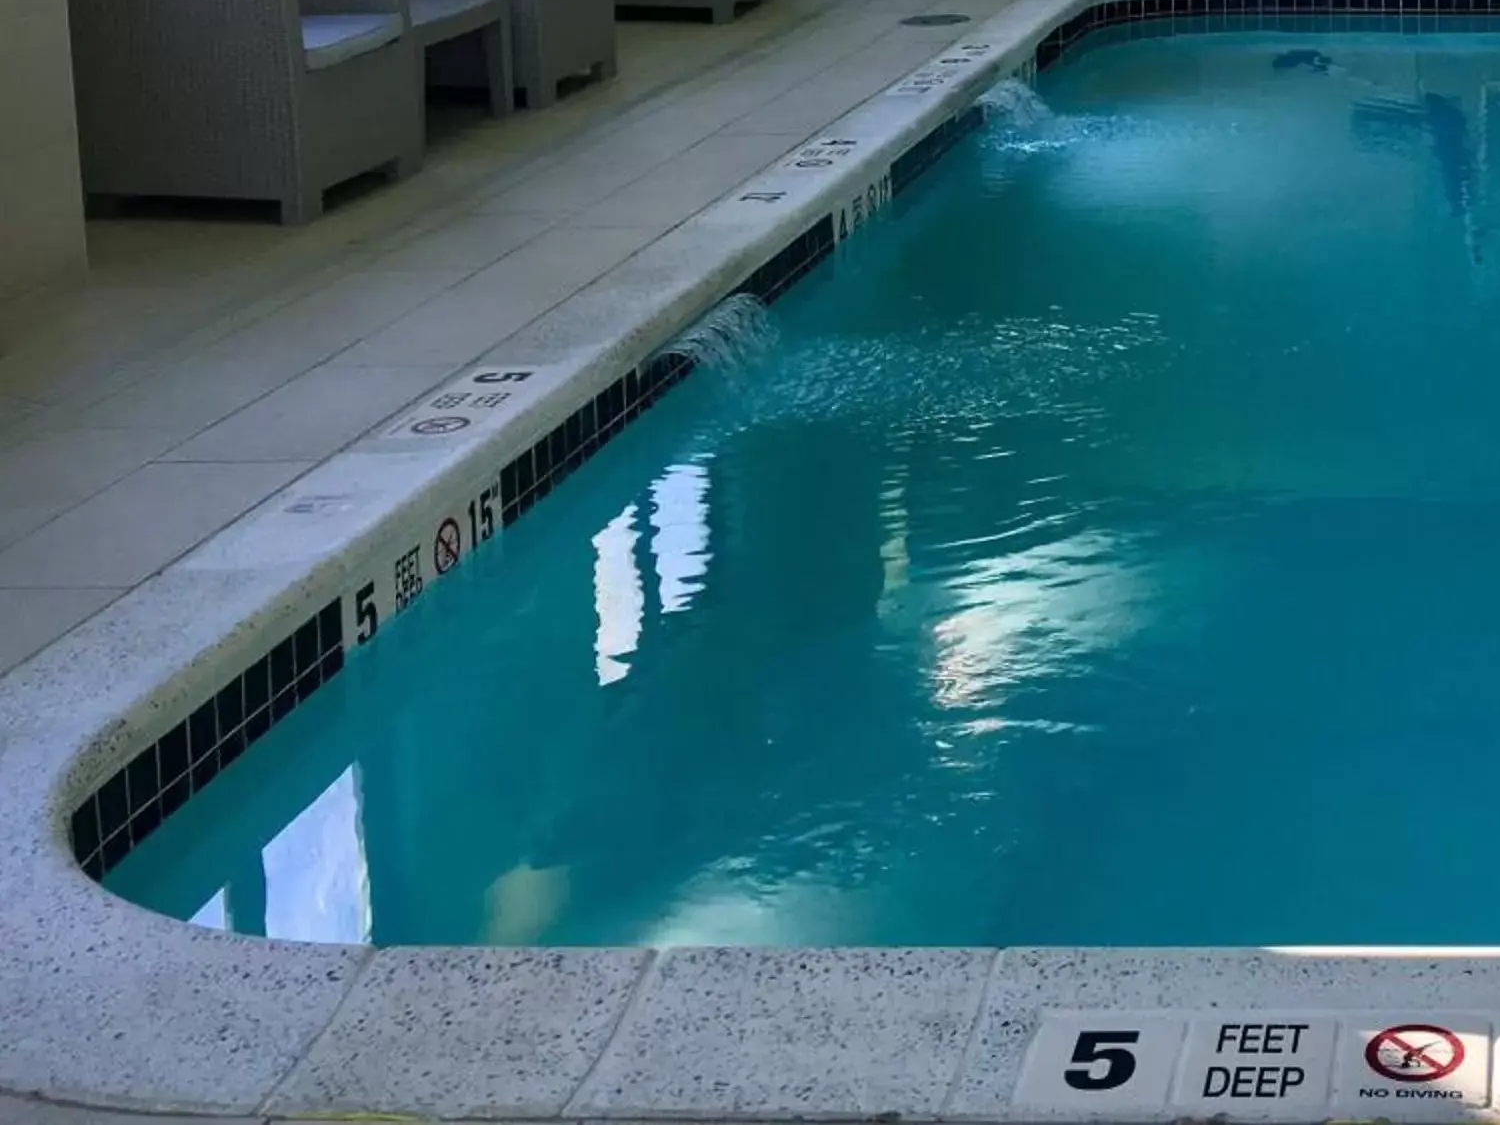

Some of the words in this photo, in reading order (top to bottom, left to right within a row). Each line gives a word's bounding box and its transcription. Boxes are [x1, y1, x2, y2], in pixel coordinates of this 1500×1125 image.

[355, 581, 379, 646] 5
[1063, 1031, 1141, 1091] 5
[1216, 1024, 1309, 1054] FEET
[1203, 1066, 1305, 1098] DEEP
[1359, 1088, 1390, 1098] NO
[1394, 1088, 1463, 1100] DIVING
